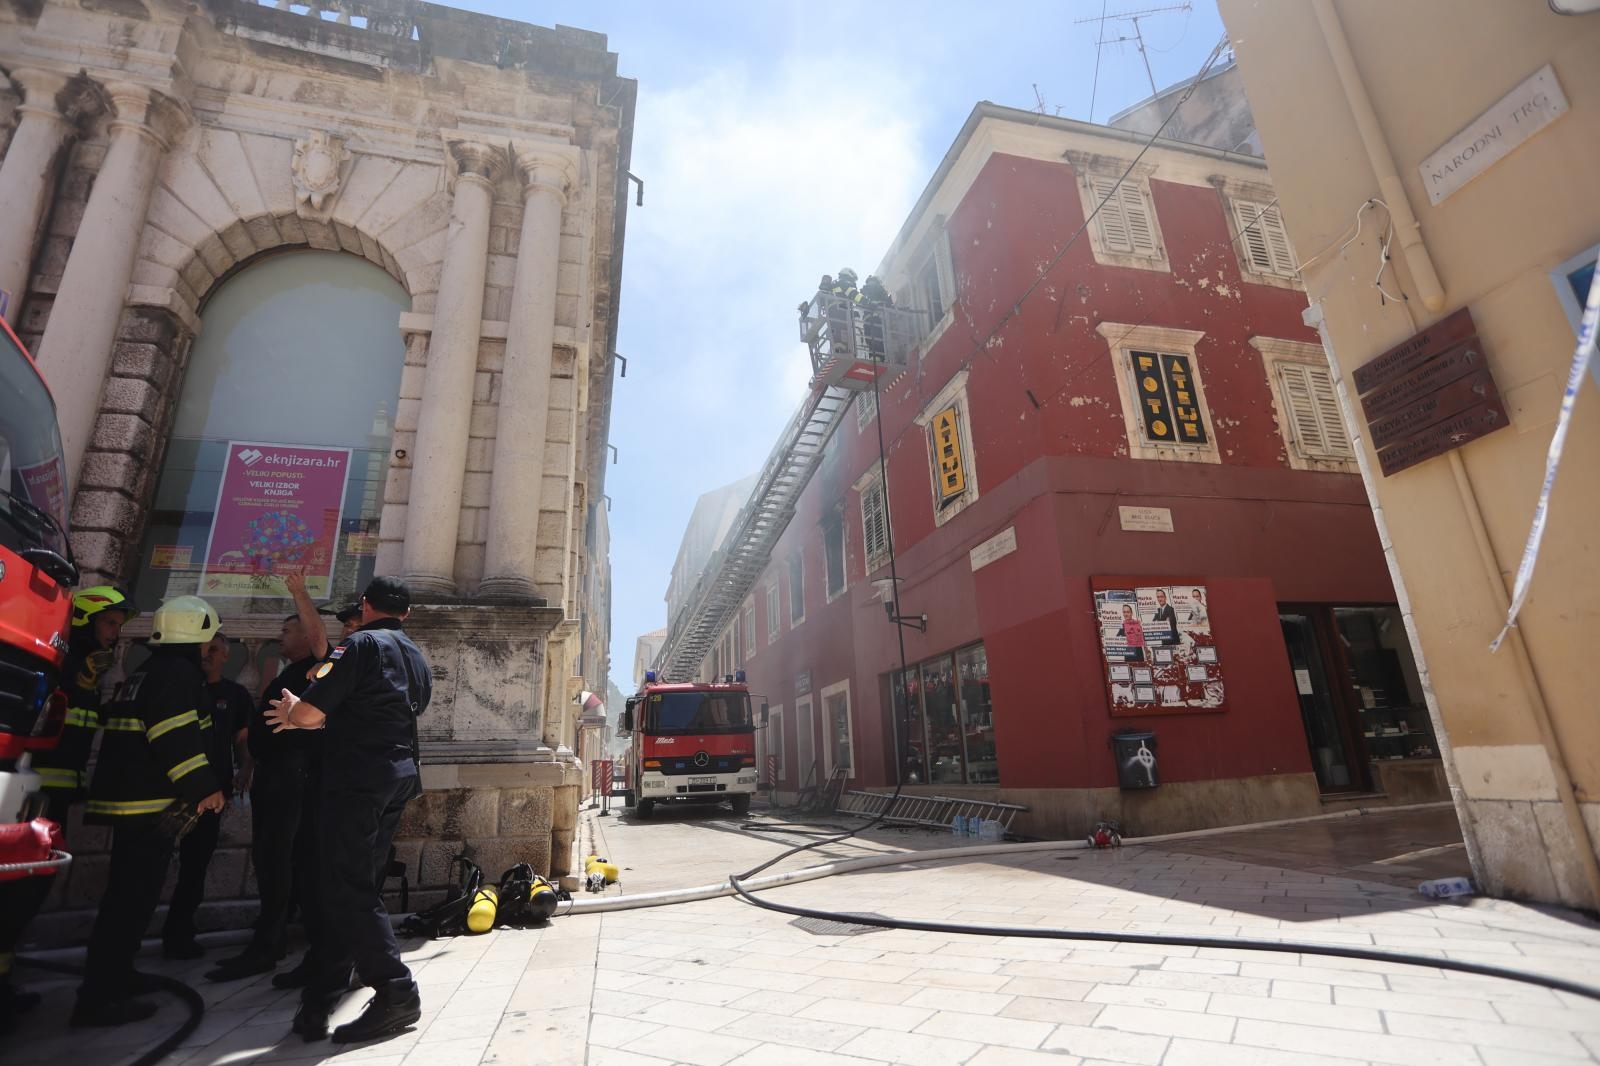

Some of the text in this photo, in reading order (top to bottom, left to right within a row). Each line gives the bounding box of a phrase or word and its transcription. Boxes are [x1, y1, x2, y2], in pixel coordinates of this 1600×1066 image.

[1431, 92, 1549, 185] NARODNI TRG
[1171, 359, 1199, 438] ATELJE
[264, 453, 340, 467] eknjizara.hr
[940, 415, 959, 489] ATELJE
[249, 480, 300, 490] VELIKI IZBOR
[263, 488, 294, 497] KNJIGA
